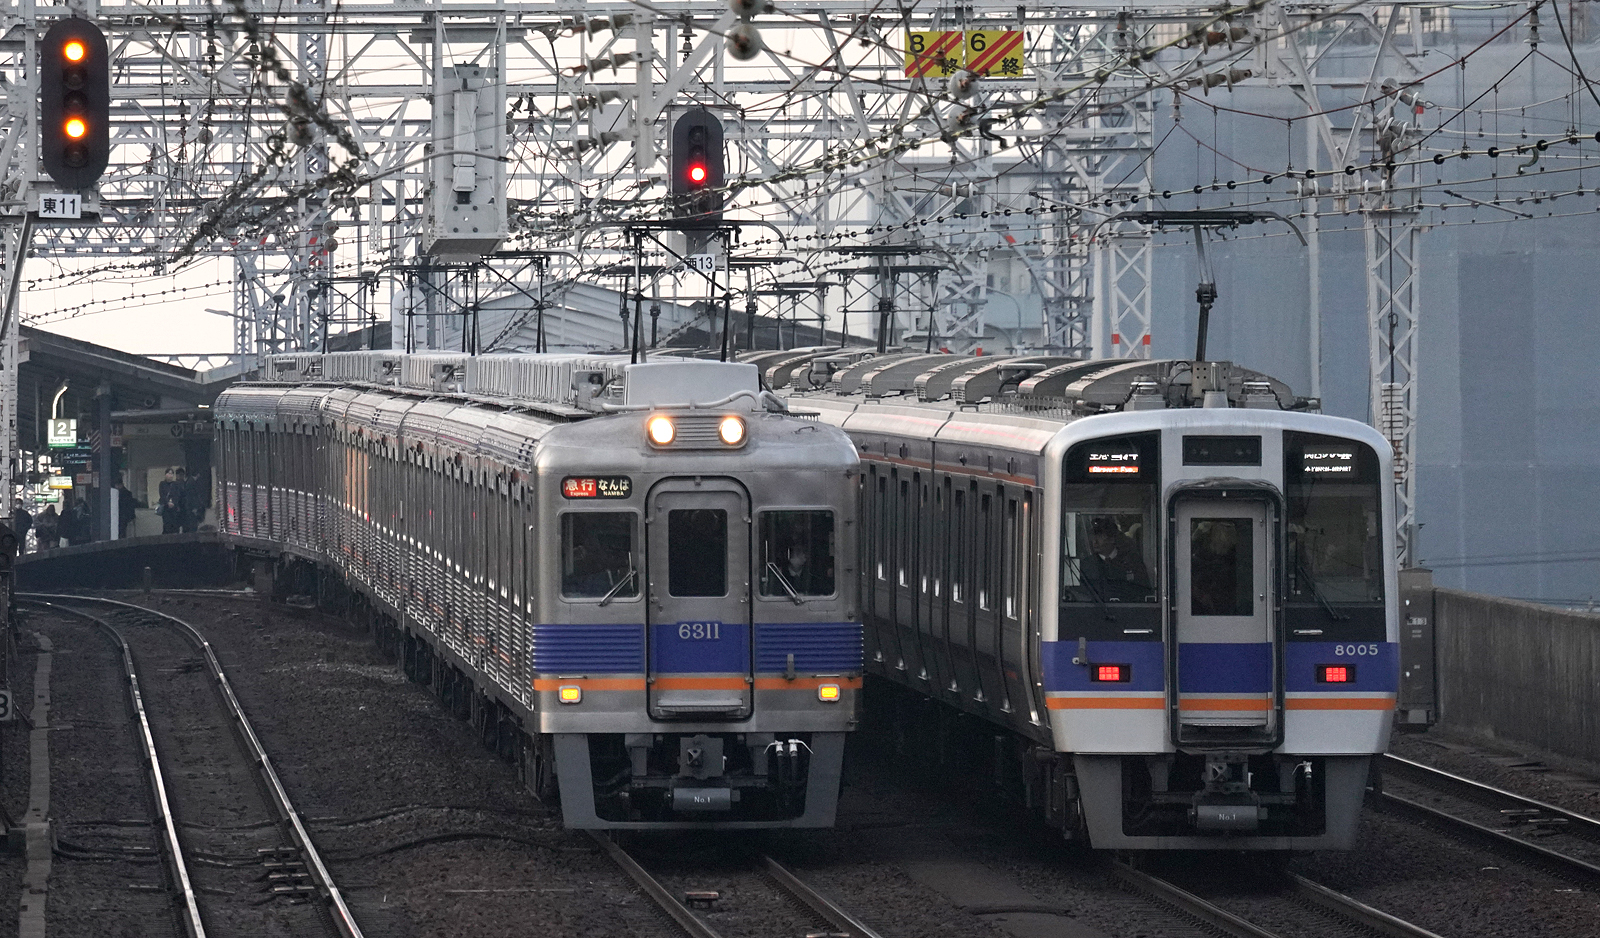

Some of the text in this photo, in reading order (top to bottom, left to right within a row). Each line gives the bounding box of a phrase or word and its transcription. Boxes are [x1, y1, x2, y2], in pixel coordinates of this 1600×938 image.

[909, 34, 925, 53] 8
[970, 33, 986, 52] 6
[1001, 57, 1020, 75] 終
[42, 197, 76, 215] 東11
[57, 422, 67, 435] 2
[565, 479, 594, 491] 急行
[678, 623, 720, 639] 6311
[1334, 644, 1379, 656] 8005
